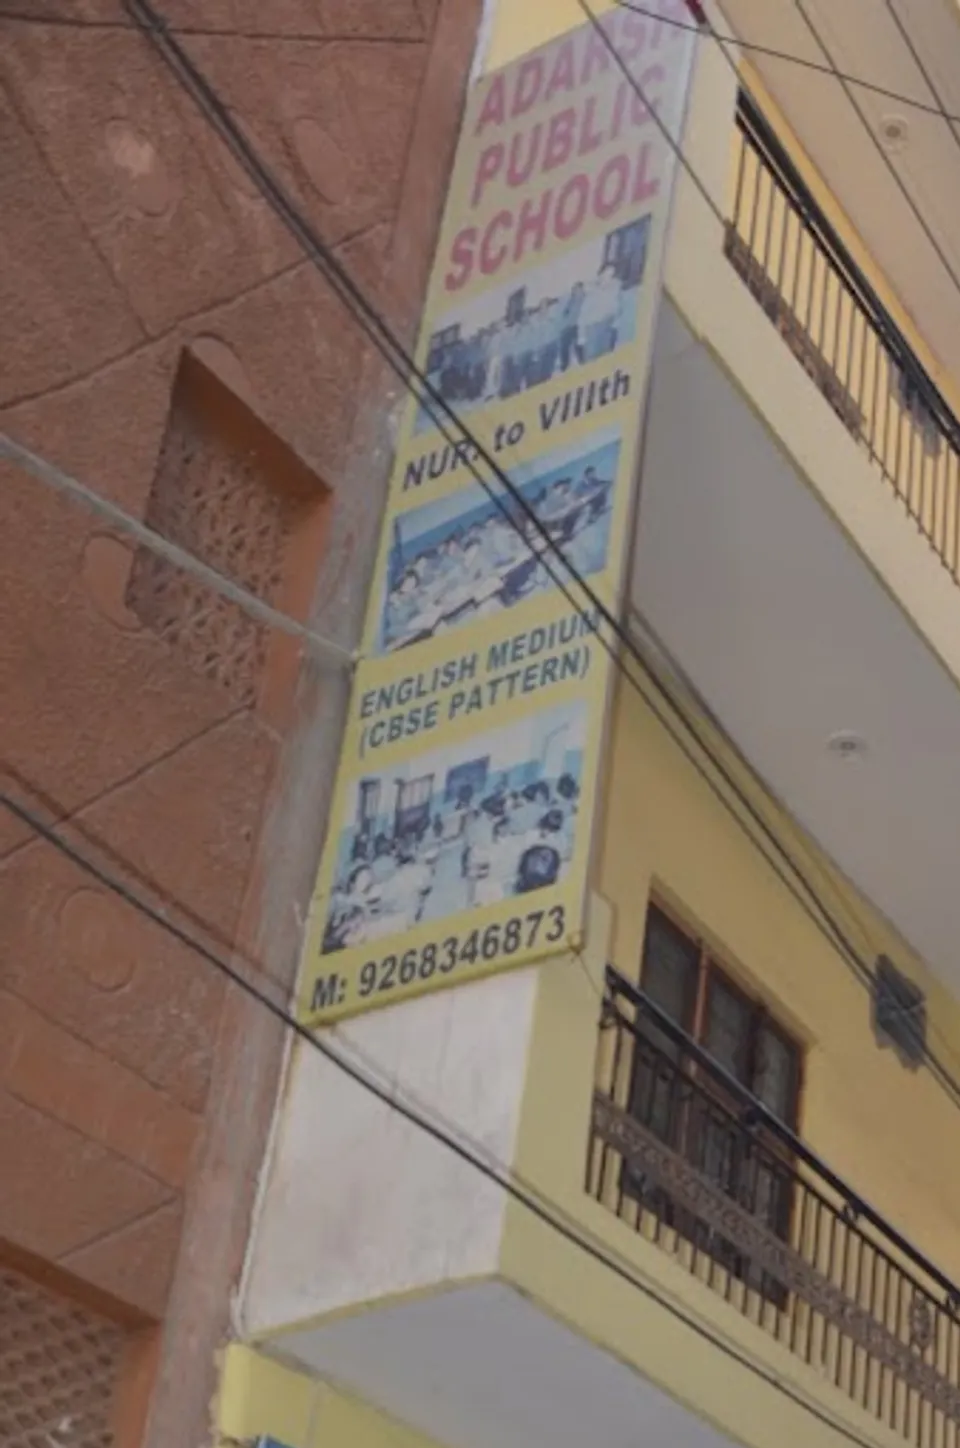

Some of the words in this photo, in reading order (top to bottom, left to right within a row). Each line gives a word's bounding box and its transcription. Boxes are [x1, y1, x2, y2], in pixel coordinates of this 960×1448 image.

[470, 64, 667, 209] PUBLIC
[444, 141, 662, 292] SCHOOL
[494, 419, 525, 454] to
[359, 653, 478, 720] ENGLISH
[487, 607, 600, 668] MEDIUM
[359, 702, 446, 760] (CBSE
[449, 644, 591, 723] PATTERN)
[310, 974, 347, 1014] M:
[358, 905, 567, 998] 9268346873
